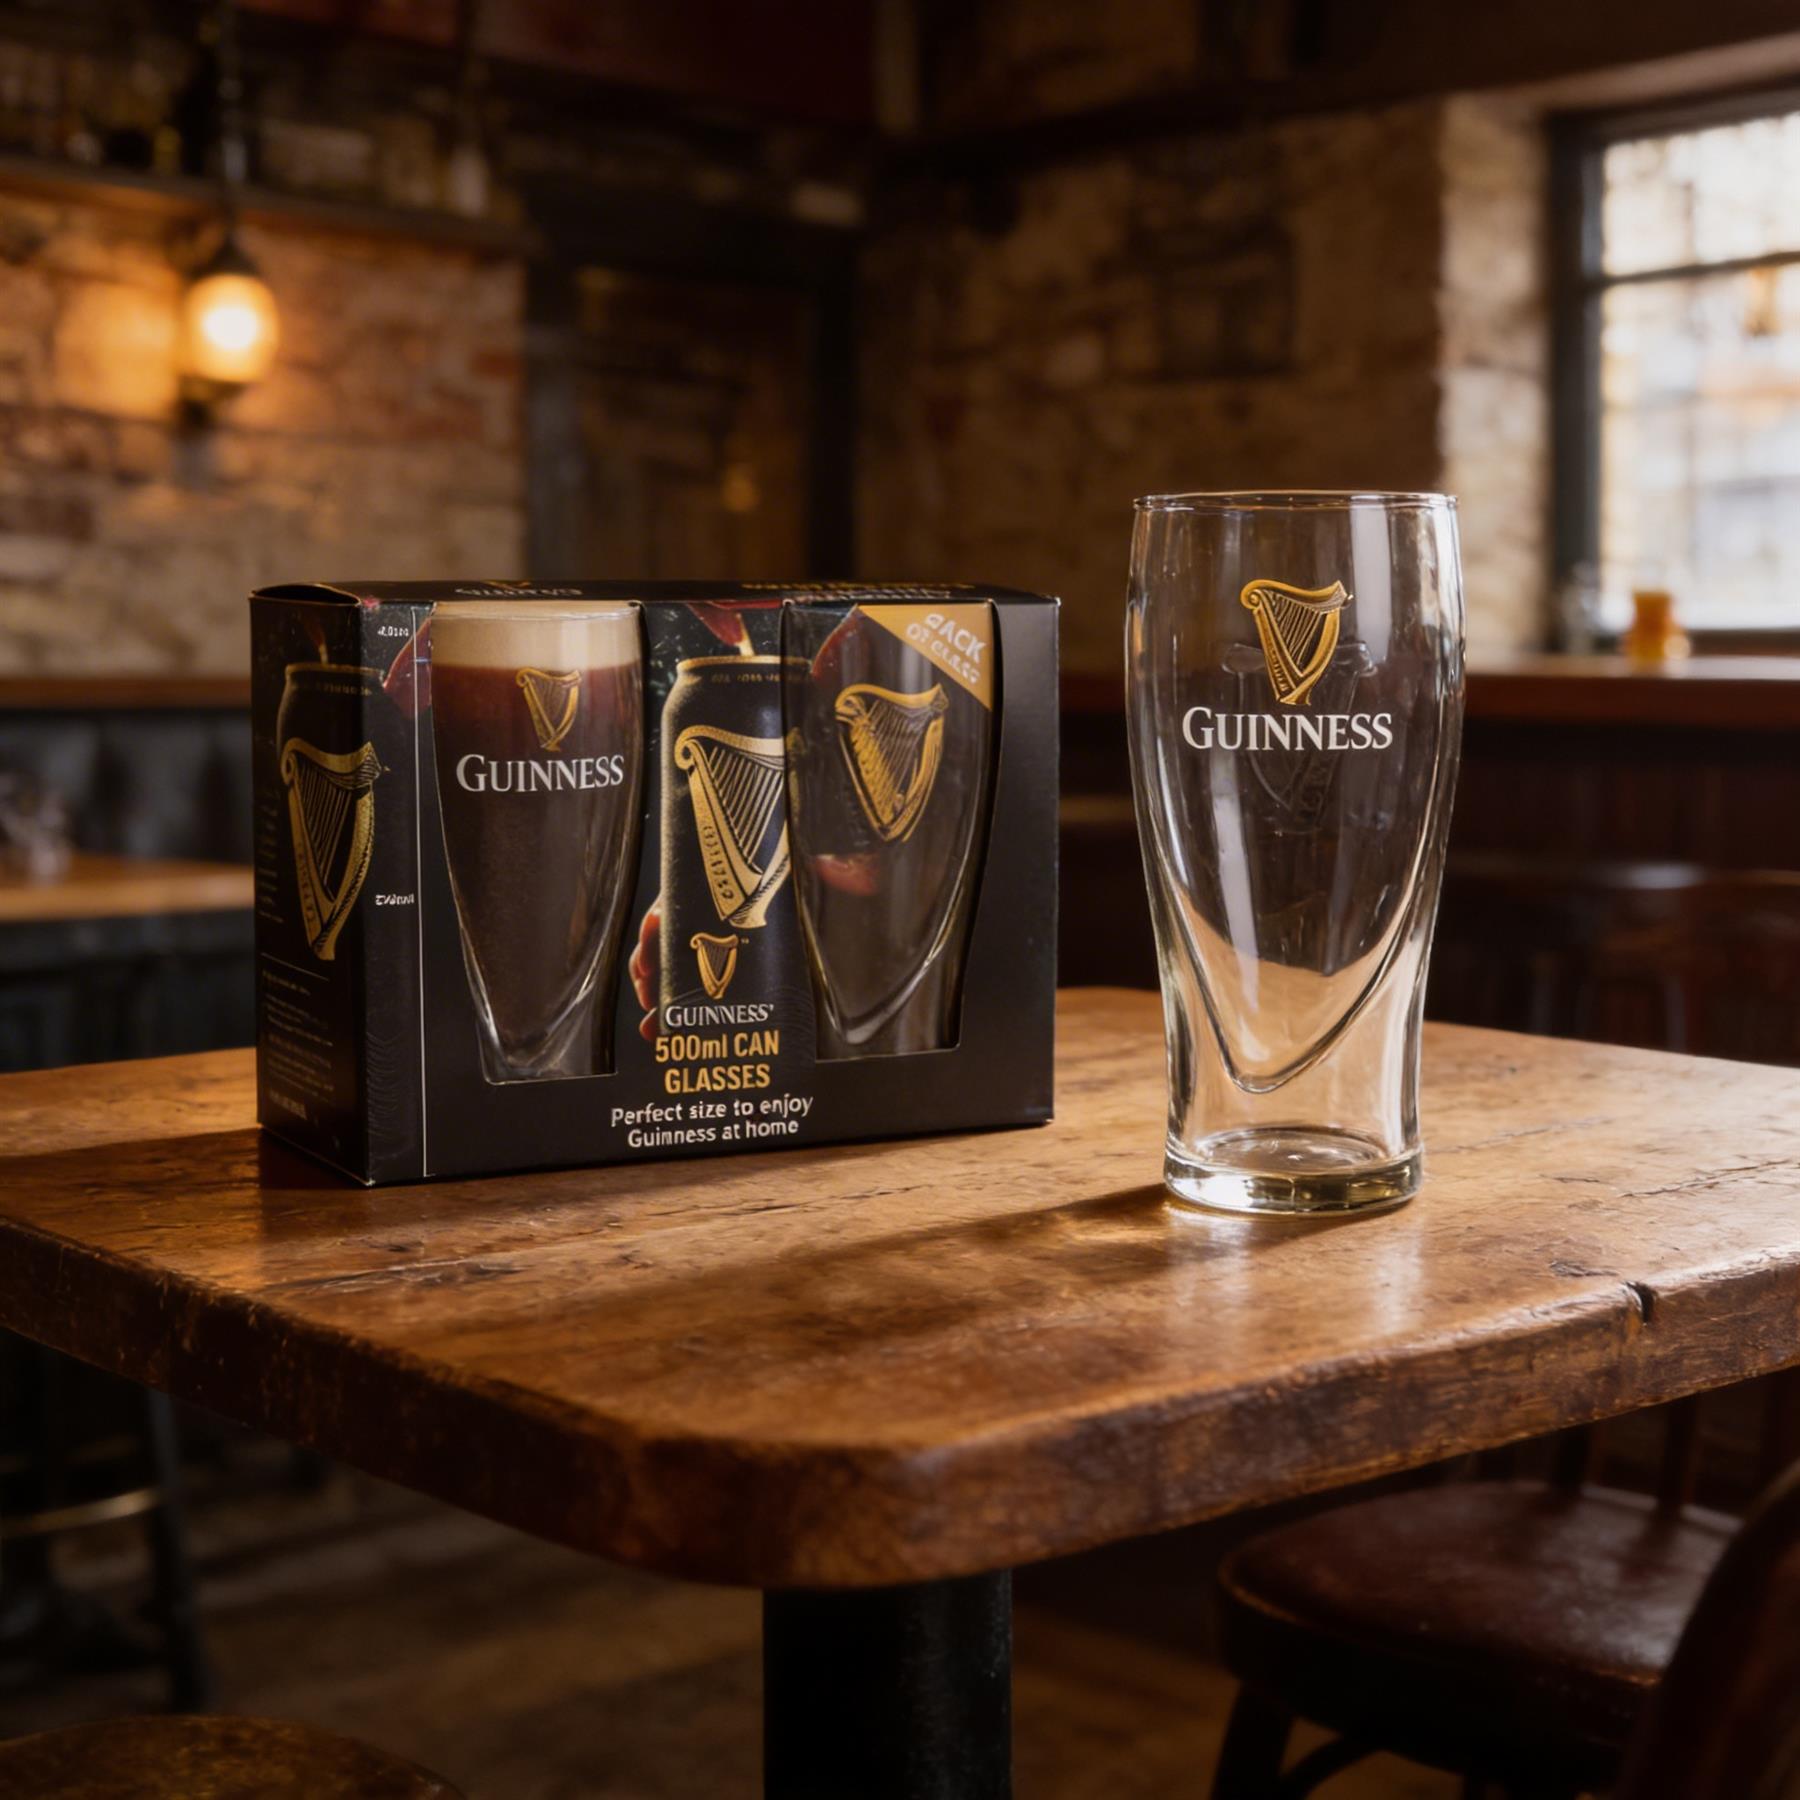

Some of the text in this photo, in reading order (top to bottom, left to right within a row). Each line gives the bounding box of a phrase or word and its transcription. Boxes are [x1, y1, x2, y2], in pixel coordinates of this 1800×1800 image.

[1182, 706, 1393, 751] GUINNESS
[456, 754, 624, 792] GUINNESS
[655, 1030, 780, 1063] 500ml CAN
[665, 1063, 771, 1094] GLASSES
[611, 1093, 814, 1127] Perfect size to enjoy
[628, 1120, 799, 1148] Guinness at home
